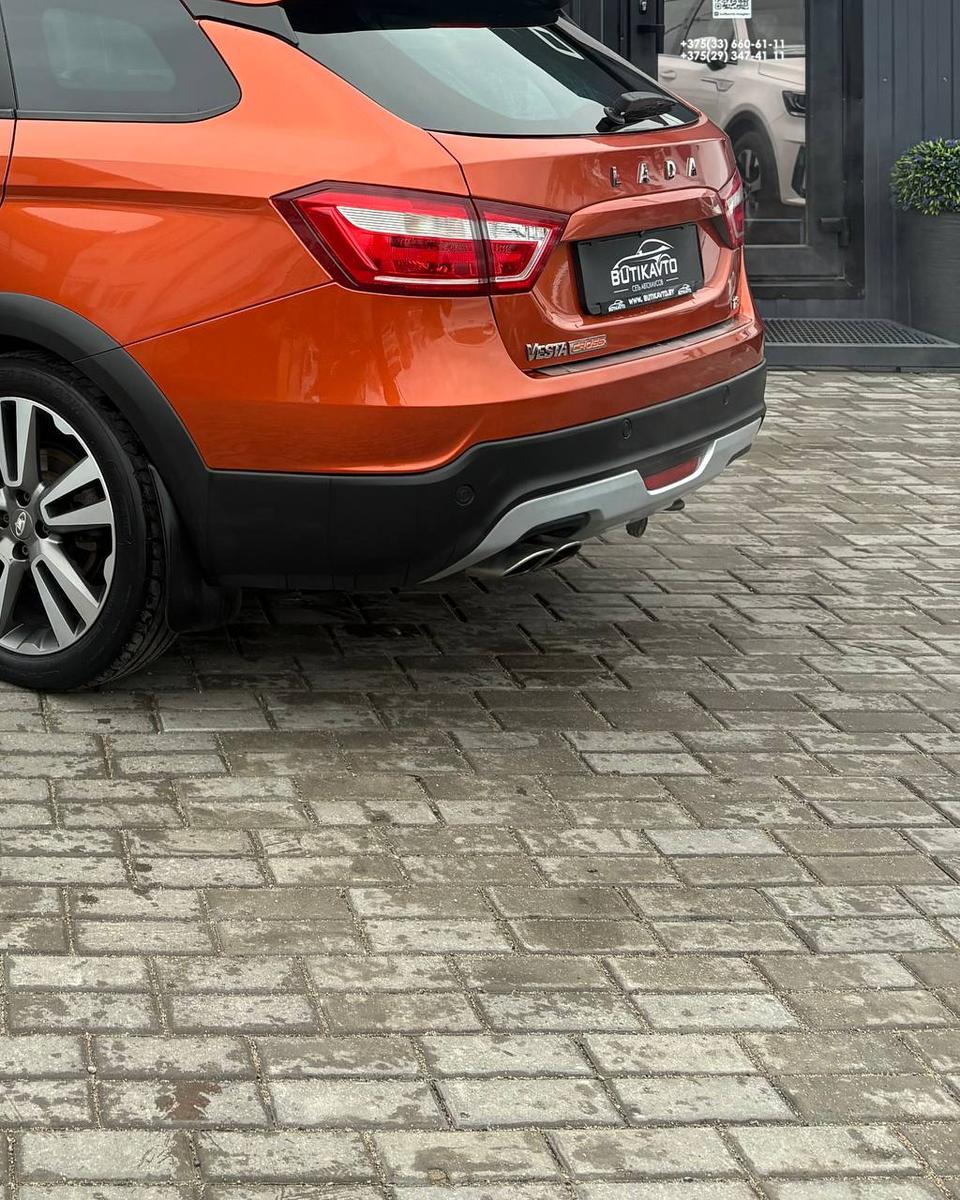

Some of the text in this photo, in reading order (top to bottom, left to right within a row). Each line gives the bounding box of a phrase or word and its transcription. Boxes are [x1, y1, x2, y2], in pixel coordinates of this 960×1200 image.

[680, 39, 785, 51] +375(33) 660-61-11
[731, 50, 785, 61] 347-4111
[610, 157, 698, 188] LADA
[610, 258, 678, 287] BUTIKAVTO
[526, 341, 568, 362] VESTA
